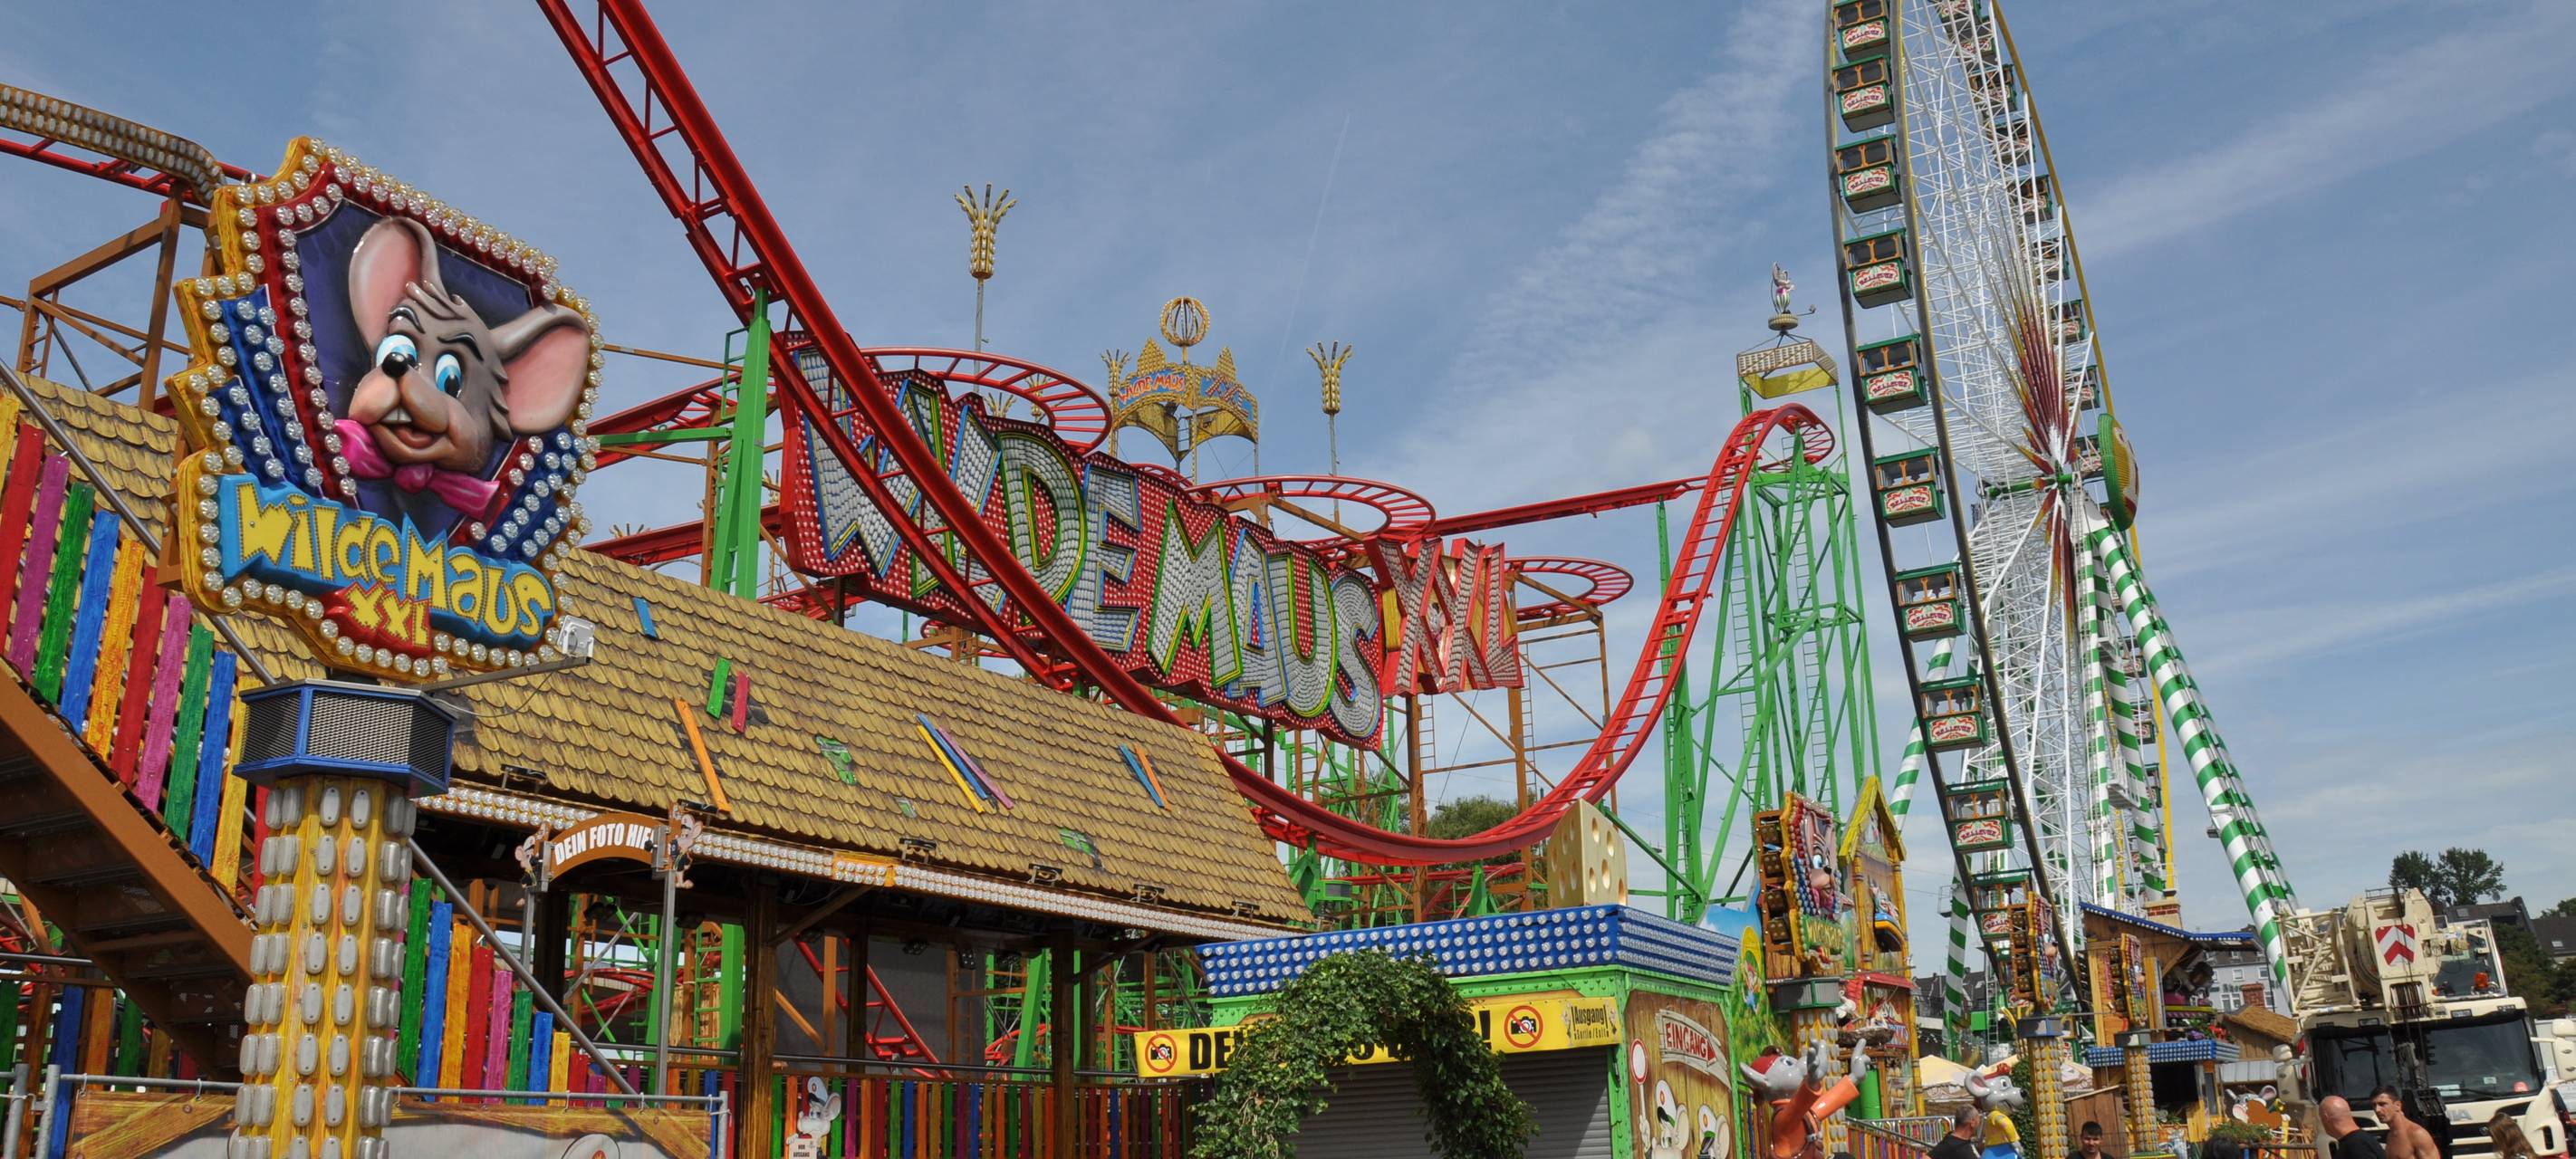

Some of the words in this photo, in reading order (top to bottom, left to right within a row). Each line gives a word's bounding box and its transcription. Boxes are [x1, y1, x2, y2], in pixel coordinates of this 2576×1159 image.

[1847, 29, 1879, 43] BELLEVUE
[1846, 95, 1879, 108] BELLEVUE
[1850, 177, 1885, 189] BELLEVUE
[1859, 273, 1894, 285] BELLEVUE
[1118, 376, 1152, 405] WILDE
[1152, 372, 1186, 392] MAUS
[1871, 380, 1908, 393] BELLEVUE
[1889, 495, 1927, 508] BELLEVUE
[793, 349, 1143, 654] WILDE
[1146, 498, 1379, 739] MAUS
[345, 585, 431, 648] XXL
[1368, 536, 1524, 695] XXL
[1911, 612, 1947, 625] BELLEVUE
[1935, 724, 1972, 737] BELLEVUE
[1960, 828, 1996, 840] BELLEVUE
[554, 830, 587, 866] DEIN
[589, 822, 625, 852] FOTO
[626, 823, 655, 853] HIE
[1574, 1006, 1605, 1026] Ausgang
[1665, 1021, 1708, 1058] EINGANG
